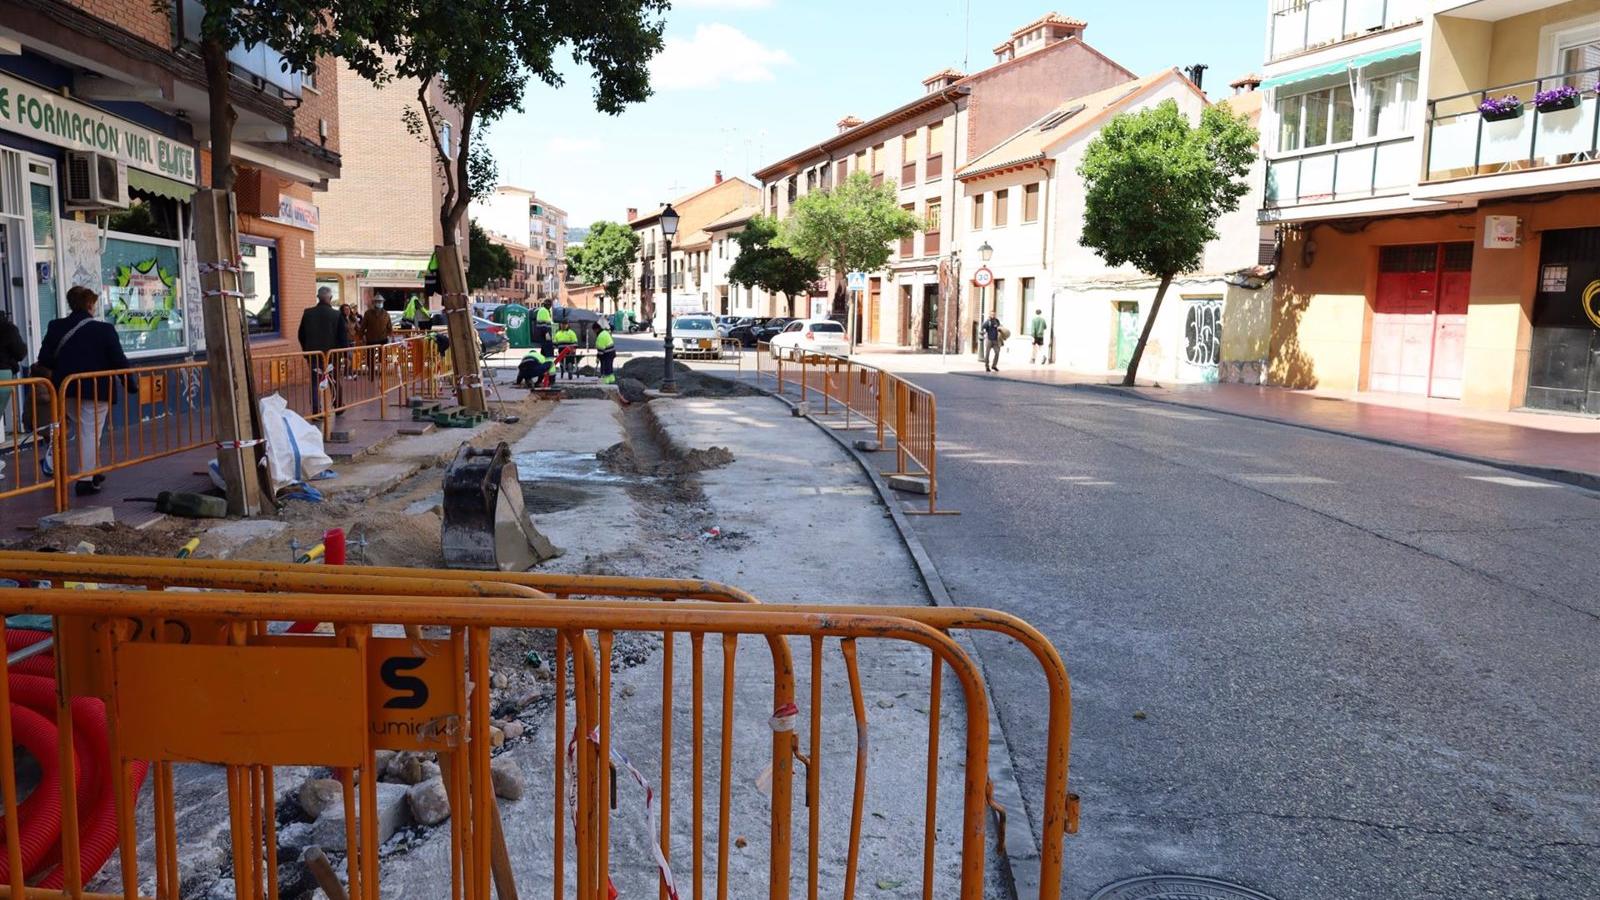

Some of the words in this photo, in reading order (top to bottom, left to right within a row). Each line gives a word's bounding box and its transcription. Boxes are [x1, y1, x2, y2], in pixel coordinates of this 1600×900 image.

[17, 93, 119, 154] FORMACIÓN
[124, 131, 153, 165] VIAL
[158, 140, 193, 179] ELITE
